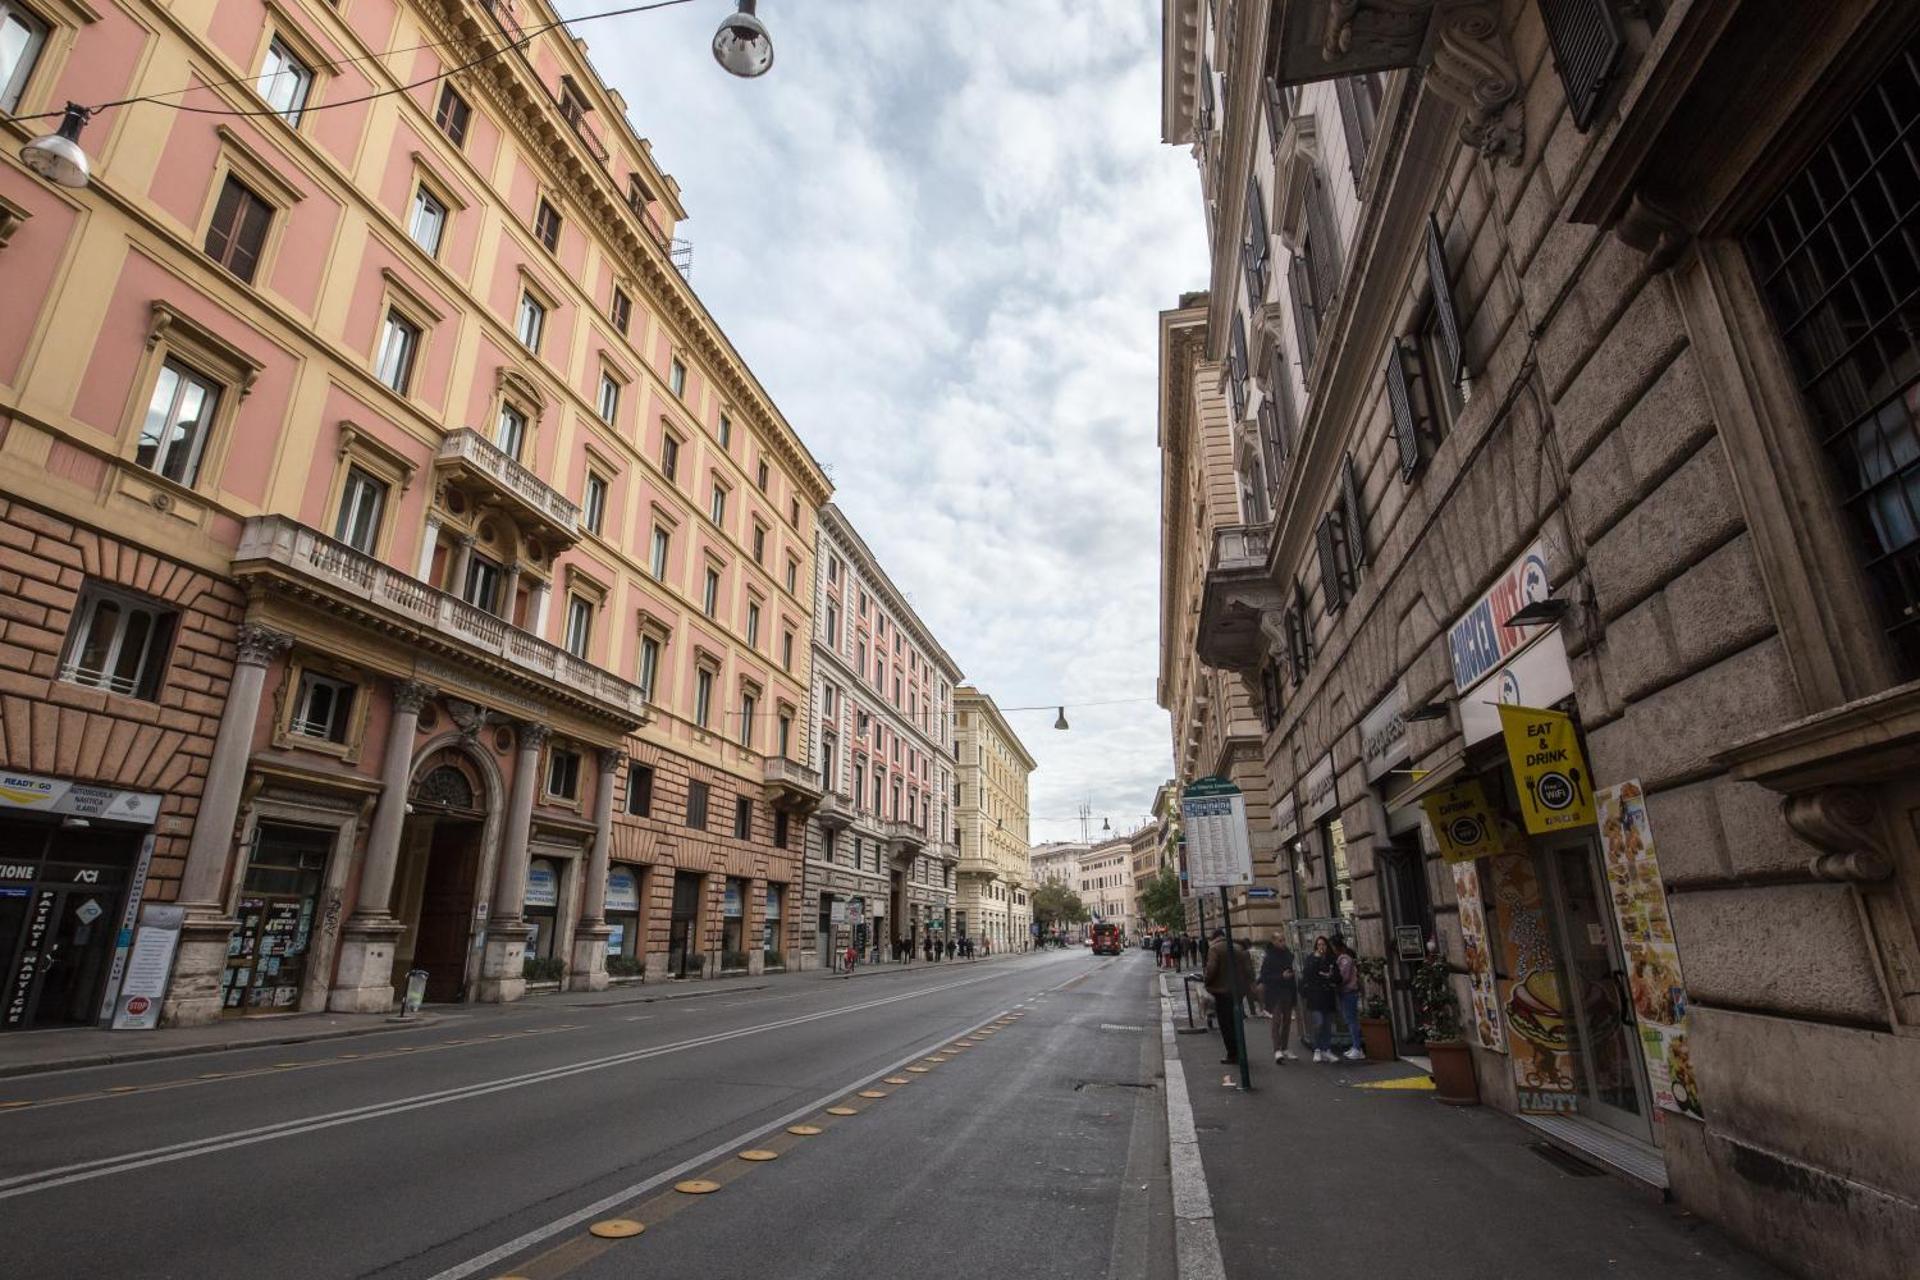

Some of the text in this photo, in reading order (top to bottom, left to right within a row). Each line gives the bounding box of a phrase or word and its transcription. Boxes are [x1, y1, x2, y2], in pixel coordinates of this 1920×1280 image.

[1450, 572, 1526, 689] CHICKEN HUT
[1527, 722, 1552, 737] EAT
[1539, 738, 1548, 749] &
[1526, 749, 1568, 767] DRINK
[1439, 800, 1476, 816] DRINK
[31, 891, 55, 948] PATENTI
[8, 956, 37, 1023] NAUTICHE
[129, 1000, 148, 1012] STOP
[1519, 1091, 1578, 1112] TASTY
